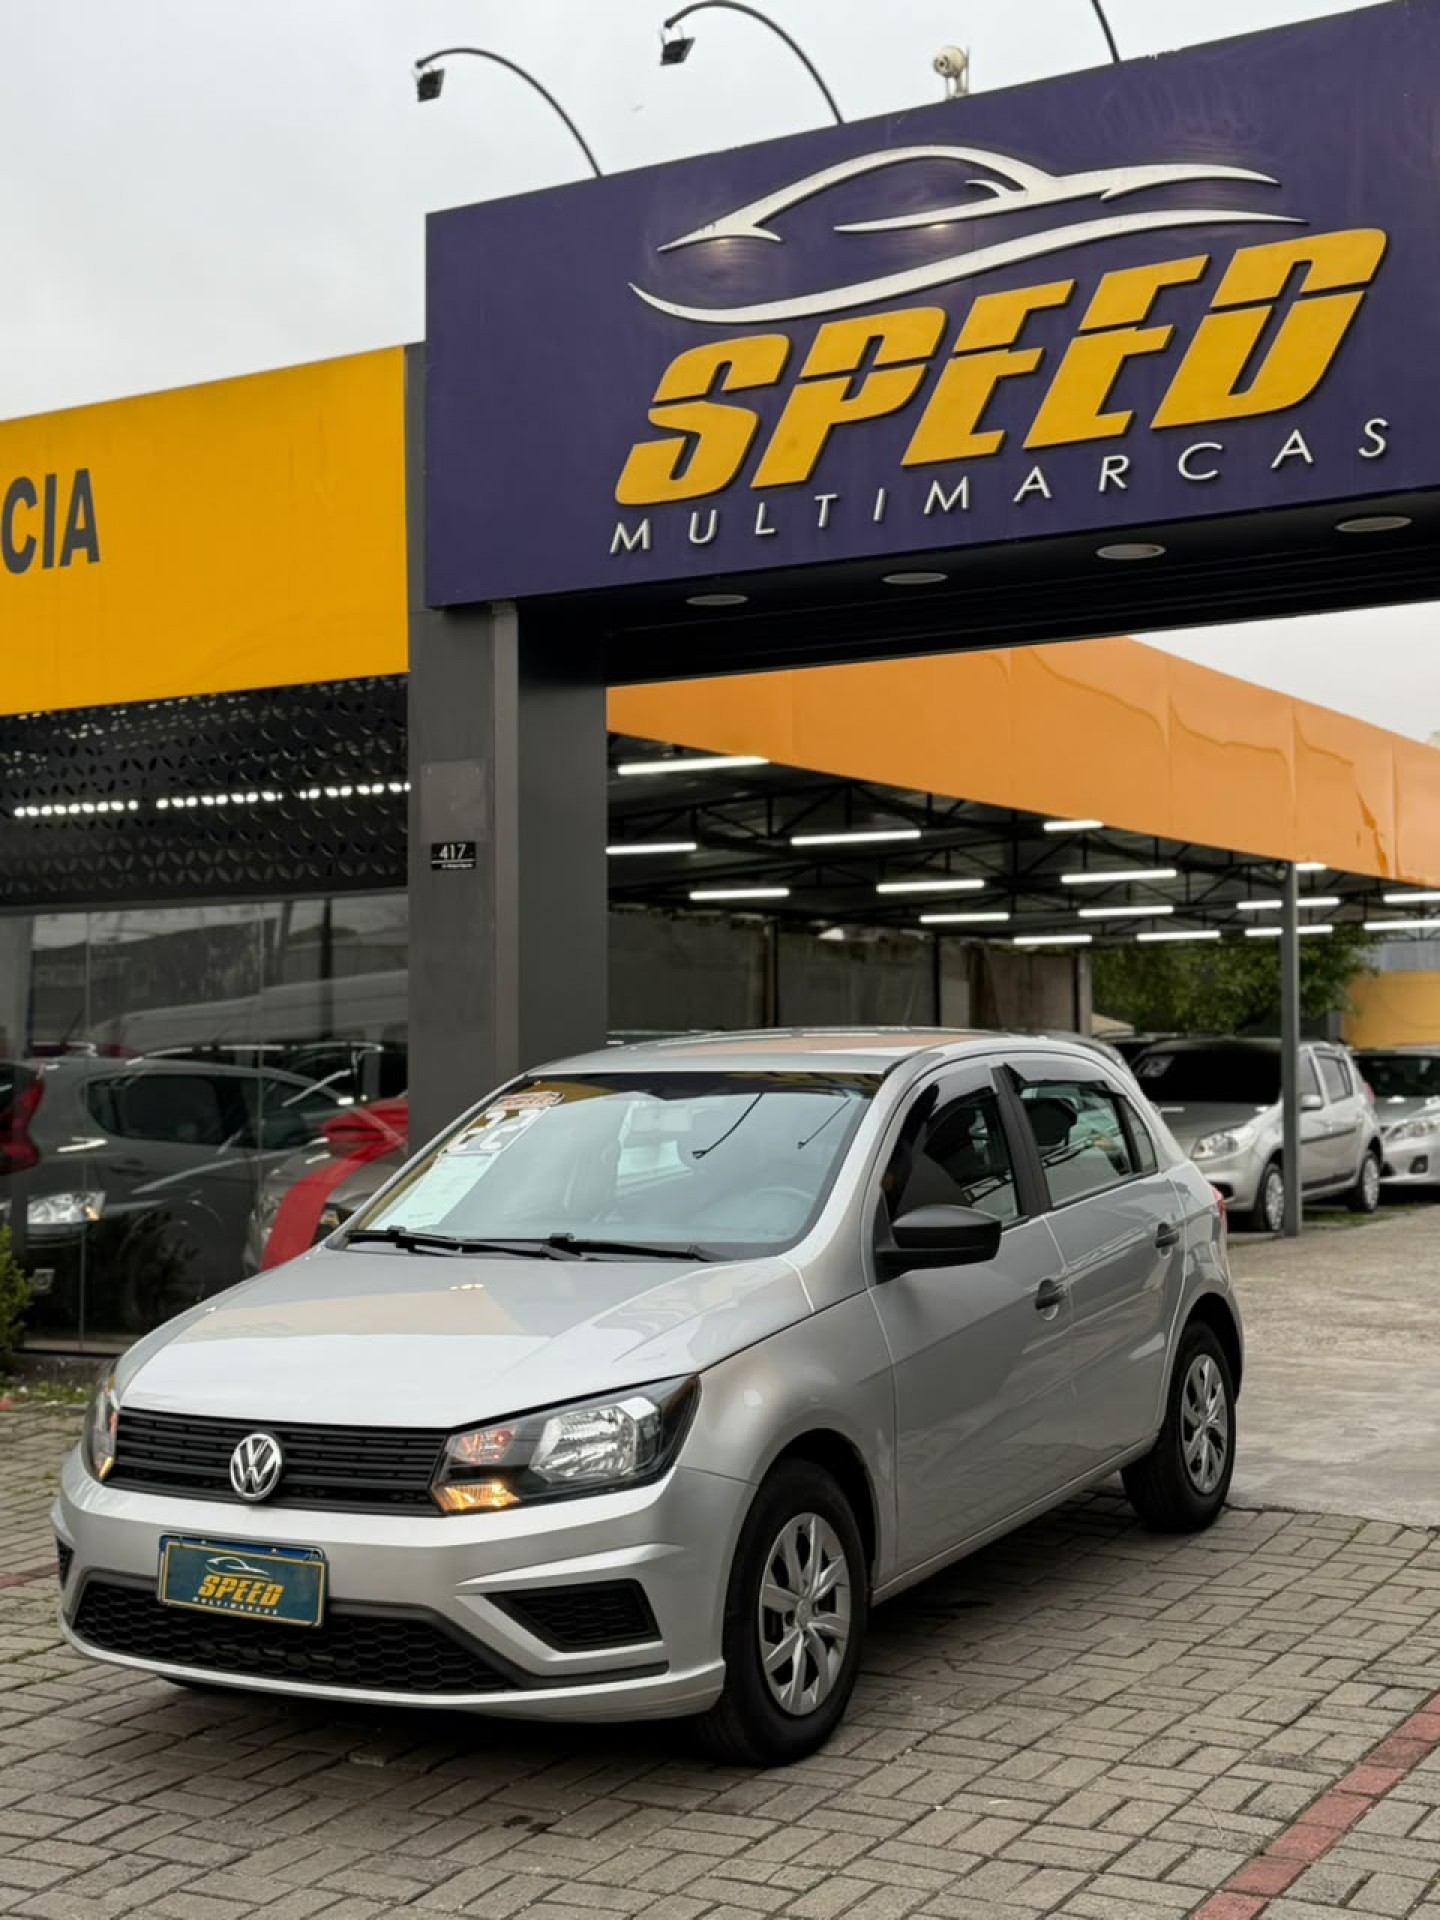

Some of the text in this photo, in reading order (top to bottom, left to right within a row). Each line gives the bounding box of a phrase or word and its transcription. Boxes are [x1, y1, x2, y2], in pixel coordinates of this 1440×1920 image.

[613, 228, 1388, 506] SPEED
[2, 467, 100, 576] CIA
[609, 418, 1390, 555] MULTIMARCAS
[439, 843, 467, 859] 417
[197, 1574, 285, 1607] SPEED
